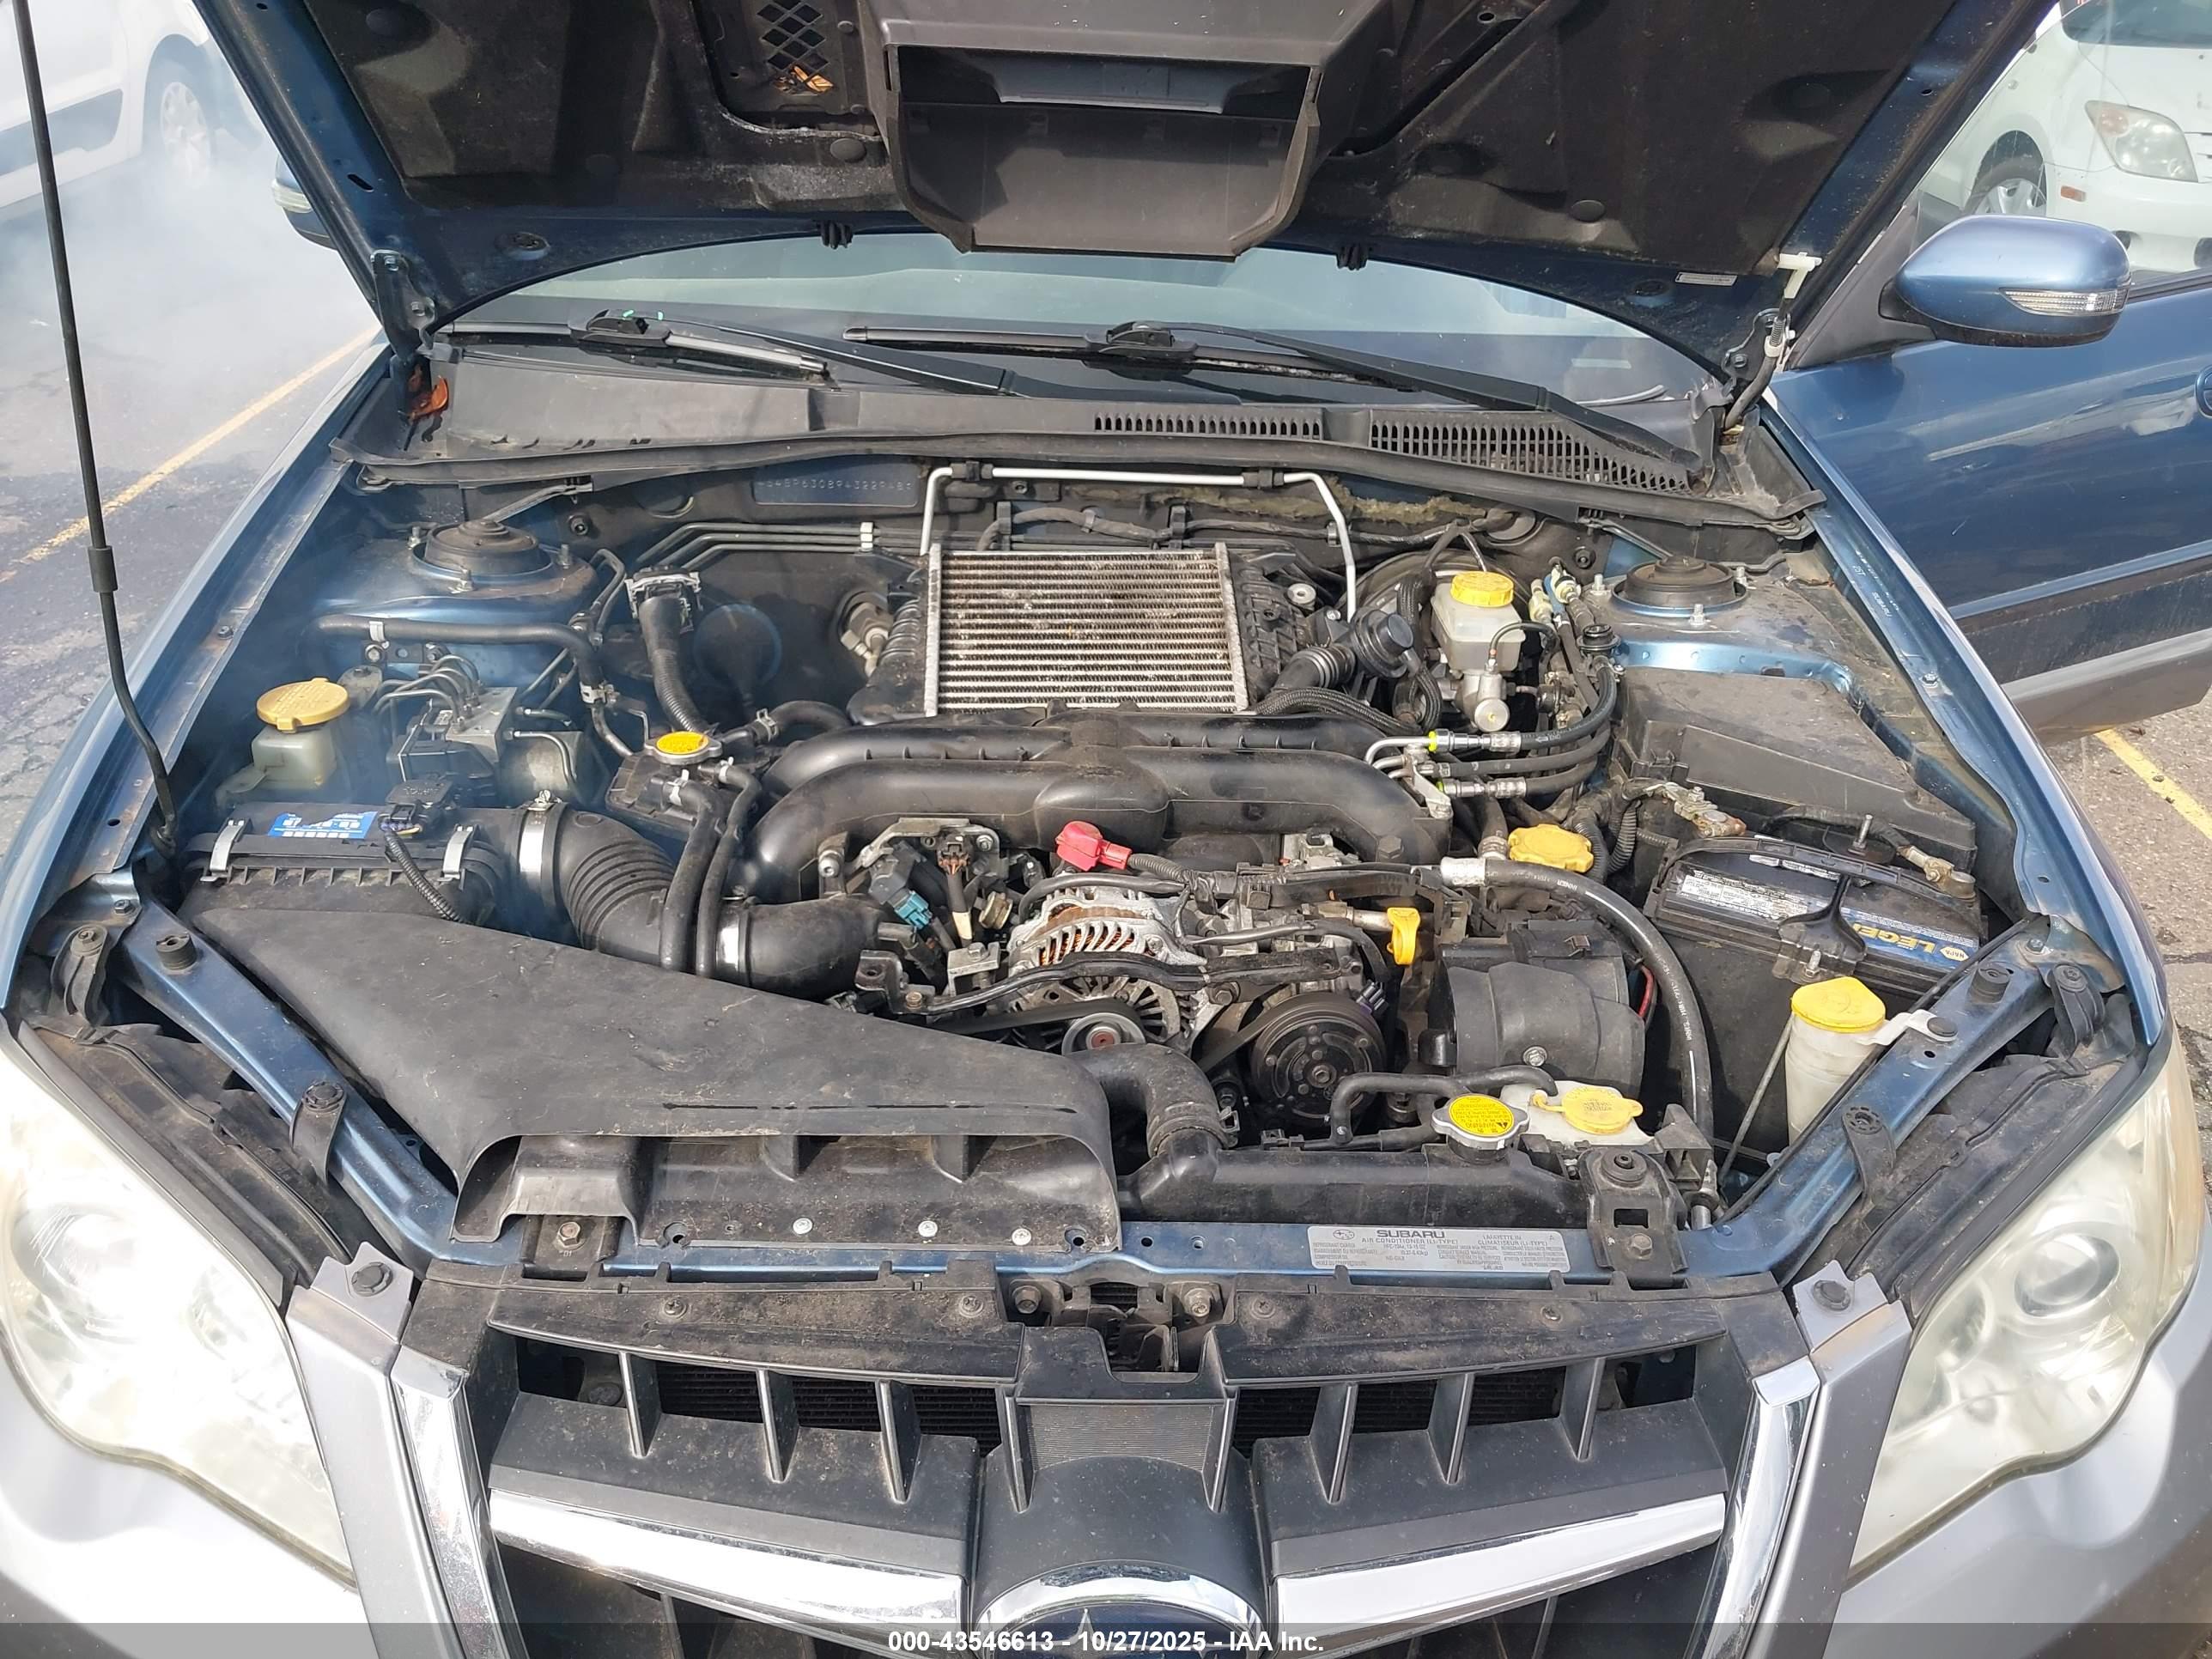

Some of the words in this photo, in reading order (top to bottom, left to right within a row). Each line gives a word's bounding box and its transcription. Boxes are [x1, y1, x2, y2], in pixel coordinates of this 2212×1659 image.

[1872, 592, 1893, 617] SUBARU
[1944, 949, 1966, 960] NAPA
[1376, 1229, 1446, 1239] SUBARU
